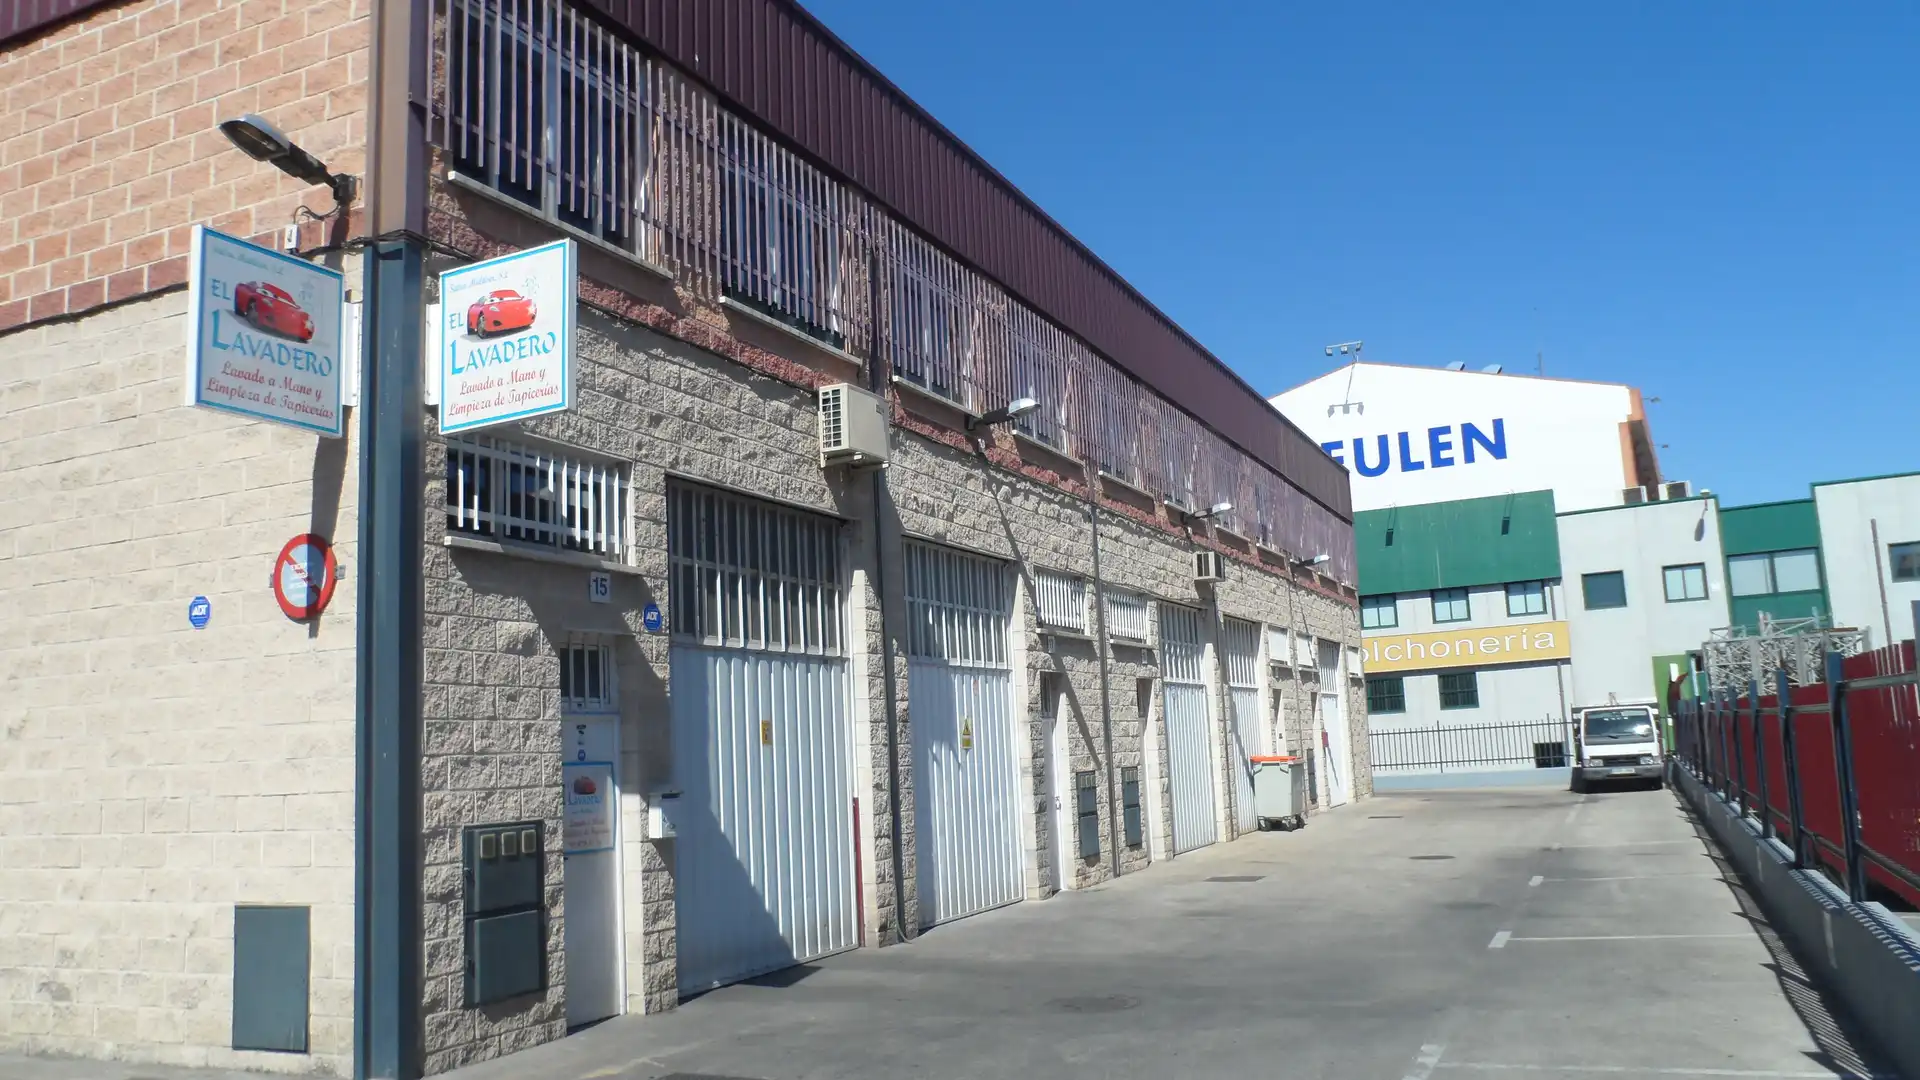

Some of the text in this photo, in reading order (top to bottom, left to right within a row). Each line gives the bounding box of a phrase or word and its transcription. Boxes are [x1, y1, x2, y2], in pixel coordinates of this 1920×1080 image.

[211, 278, 231, 300] EL
[449, 312, 464, 330] EL
[211, 309, 332, 377] LAVADERO
[450, 331, 556, 375] LAVADERO
[206, 377, 260, 402] Limpieza
[263, 392, 276, 406] de
[221, 361, 323, 402] Lavado a Mano y
[460, 368, 546, 395] Lavado a Mano y
[449, 400, 491, 417] Limpieza
[494, 392, 505, 406] de
[592, 577, 607, 596] 15
[191, 604, 208, 617] ADT
[646, 611, 659, 621] ADT
